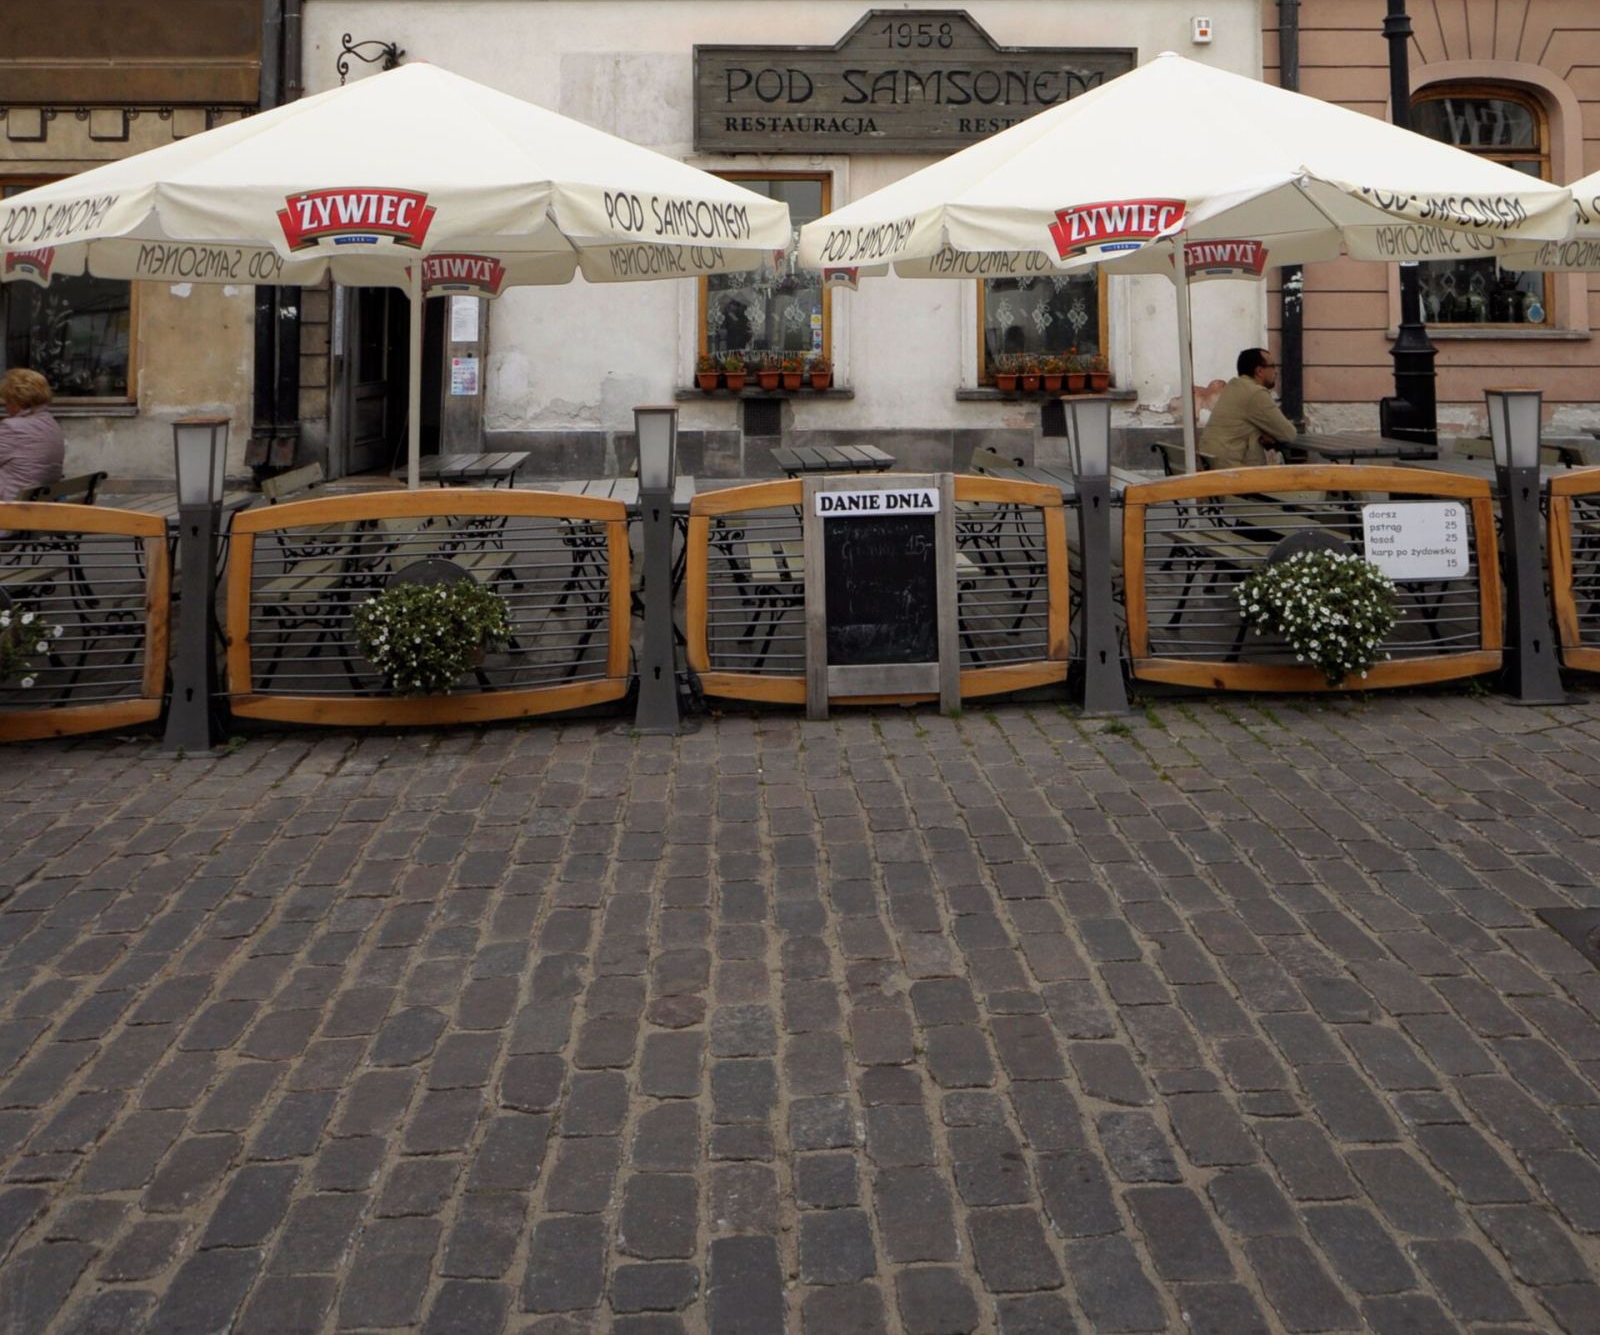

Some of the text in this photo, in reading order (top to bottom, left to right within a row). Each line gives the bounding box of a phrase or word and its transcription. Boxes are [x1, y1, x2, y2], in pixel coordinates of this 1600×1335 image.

[882, 22, 953, 49] 1958
[725, 68, 1105, 105] POD SAMSONEM
[725, 117, 878, 136] RESTAURACJA
[296, 194, 417, 231] ŻYWIEC
[603, 191, 750, 240] POD SAMSONEM
[1065, 204, 1176, 241] ŻYWIEC
[0, 205, 38, 244] POD
[820, 217, 916, 262] POD SAMSONEM
[820, 493, 934, 511] DANIE DNIA
[1368, 508, 1457, 519] dorsz 20
[1444, 521, 1458, 530] 25
[1369, 533, 1458, 544] łosoś 25
[1371, 548, 1394, 558] karp
[1396, 549, 1408, 558] po
[1446, 559, 1458, 568] 15
